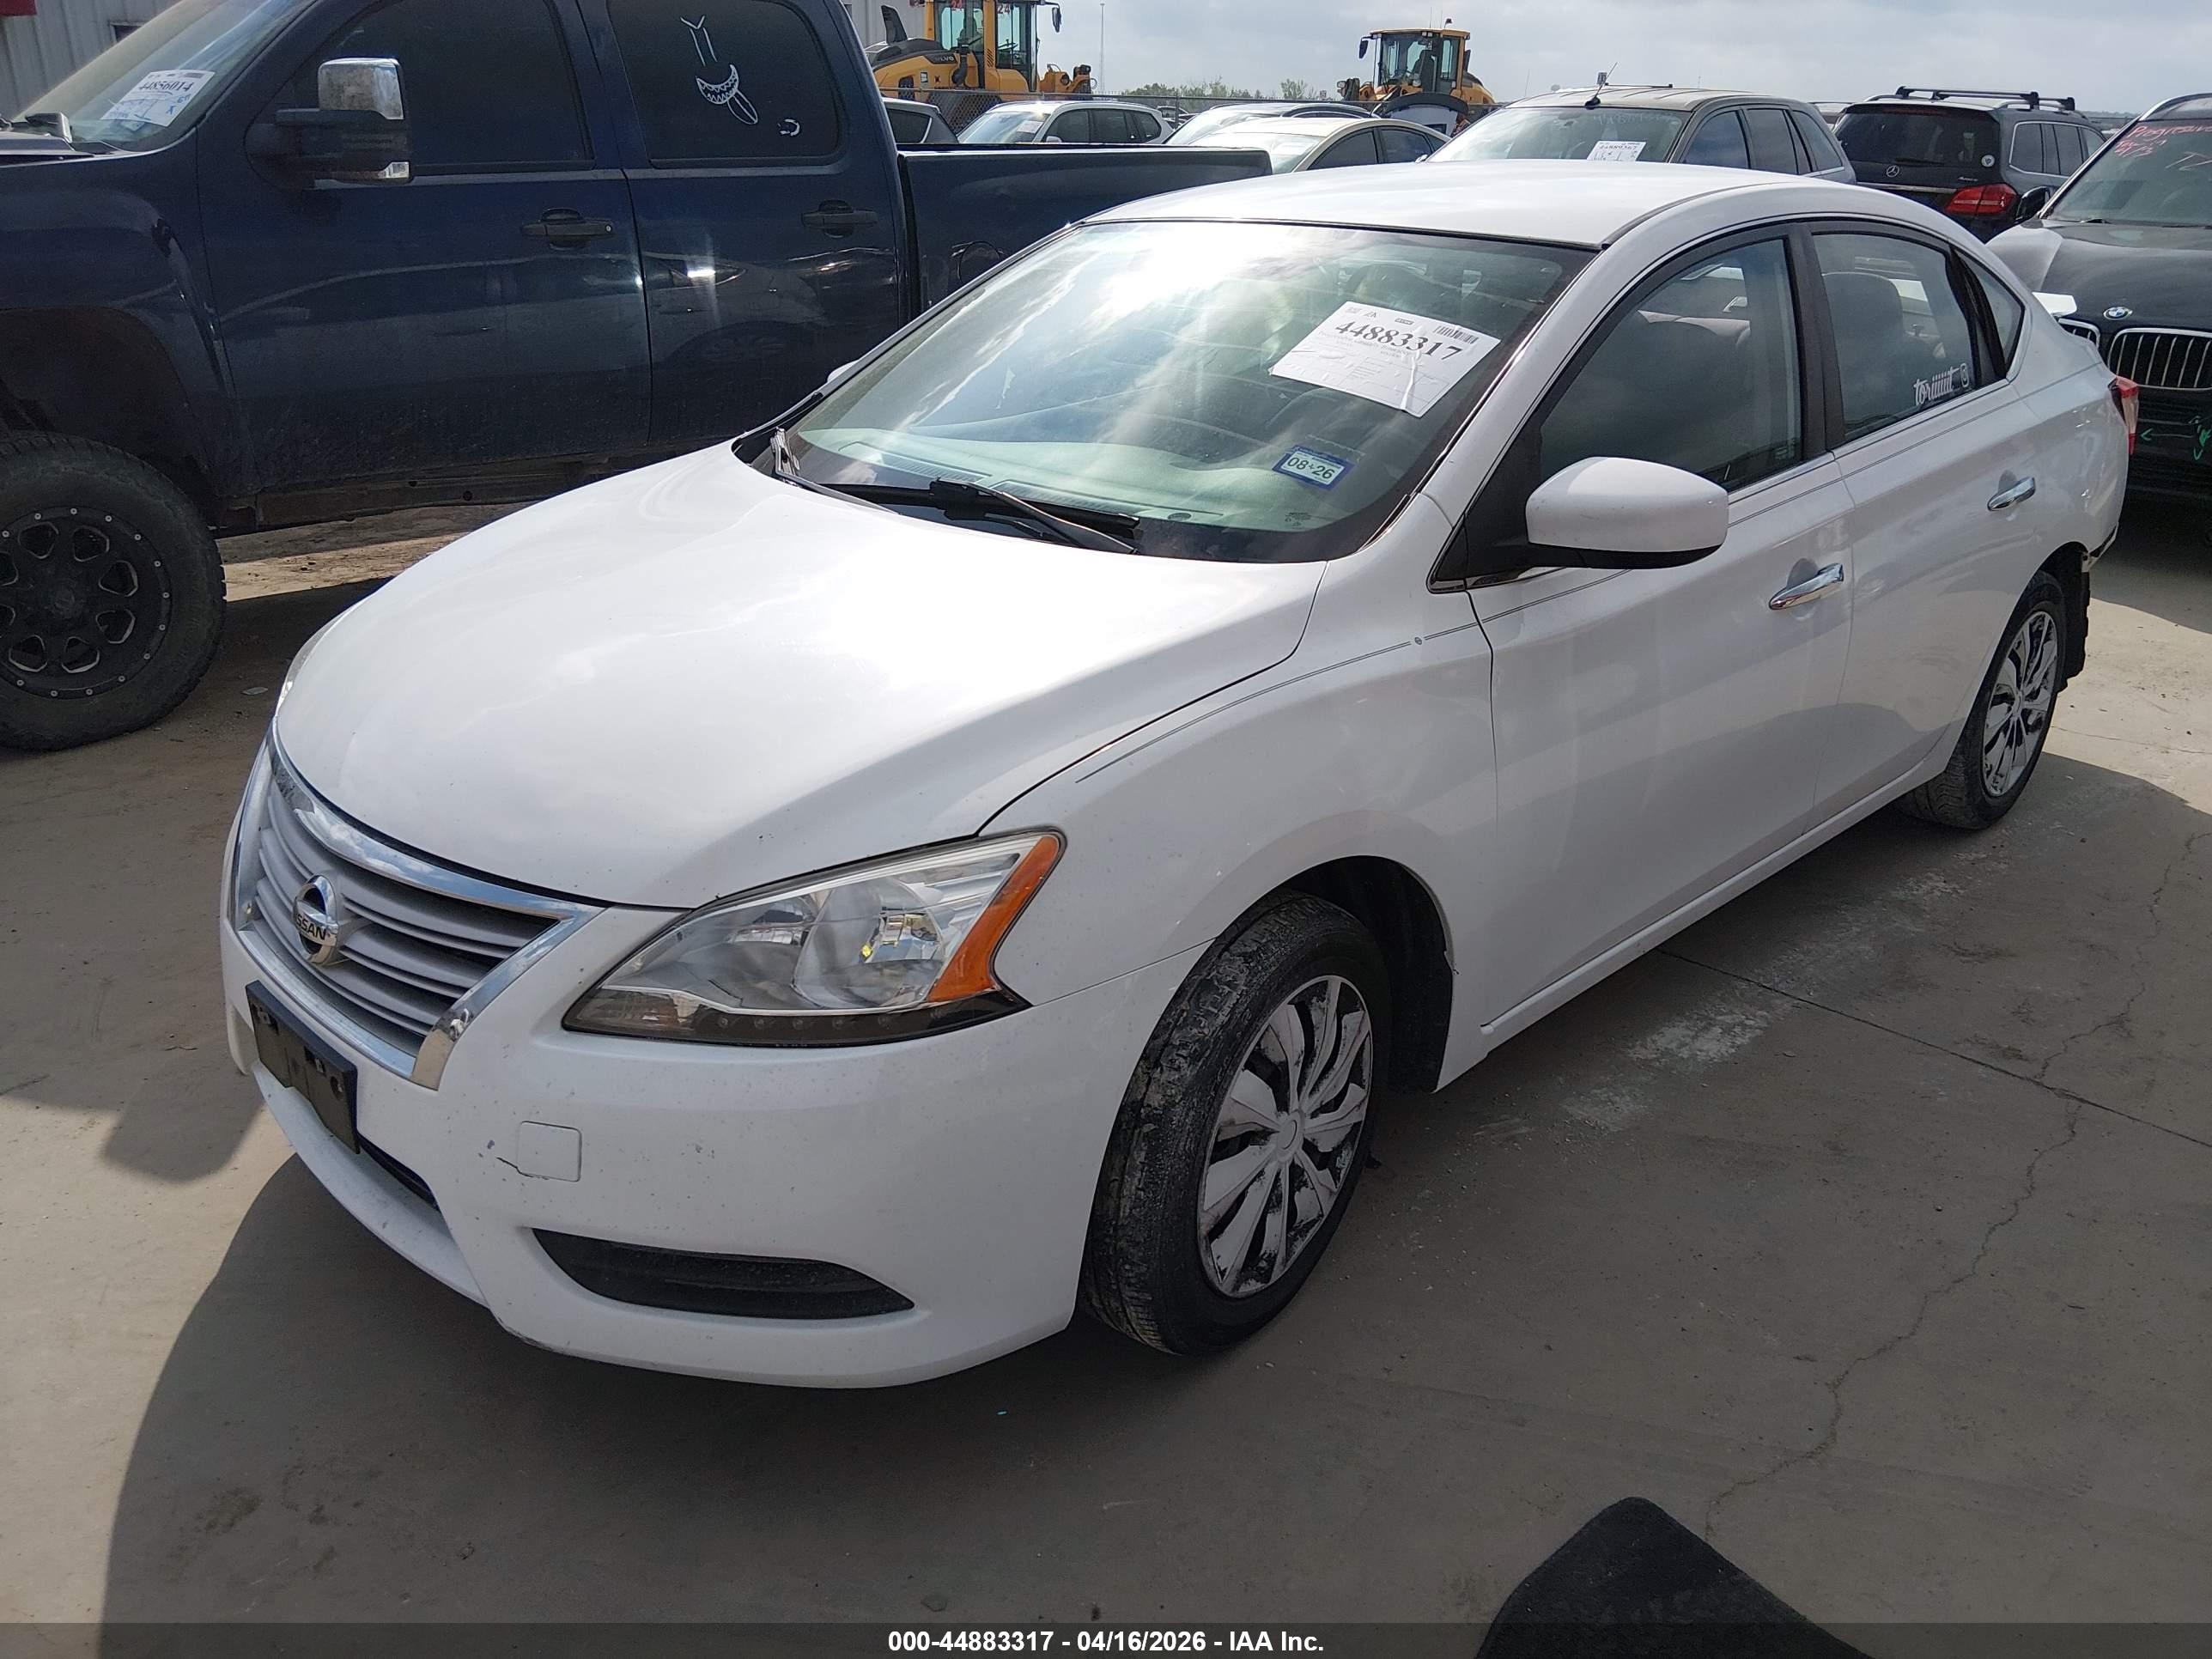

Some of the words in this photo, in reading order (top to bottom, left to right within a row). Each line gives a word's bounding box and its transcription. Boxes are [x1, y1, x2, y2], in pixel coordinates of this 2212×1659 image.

[1334, 321, 1464, 361] 44883317
[1287, 457, 1310, 471] 08
[1311, 465, 1335, 479] 26
[295, 913, 326, 940] SSAN
